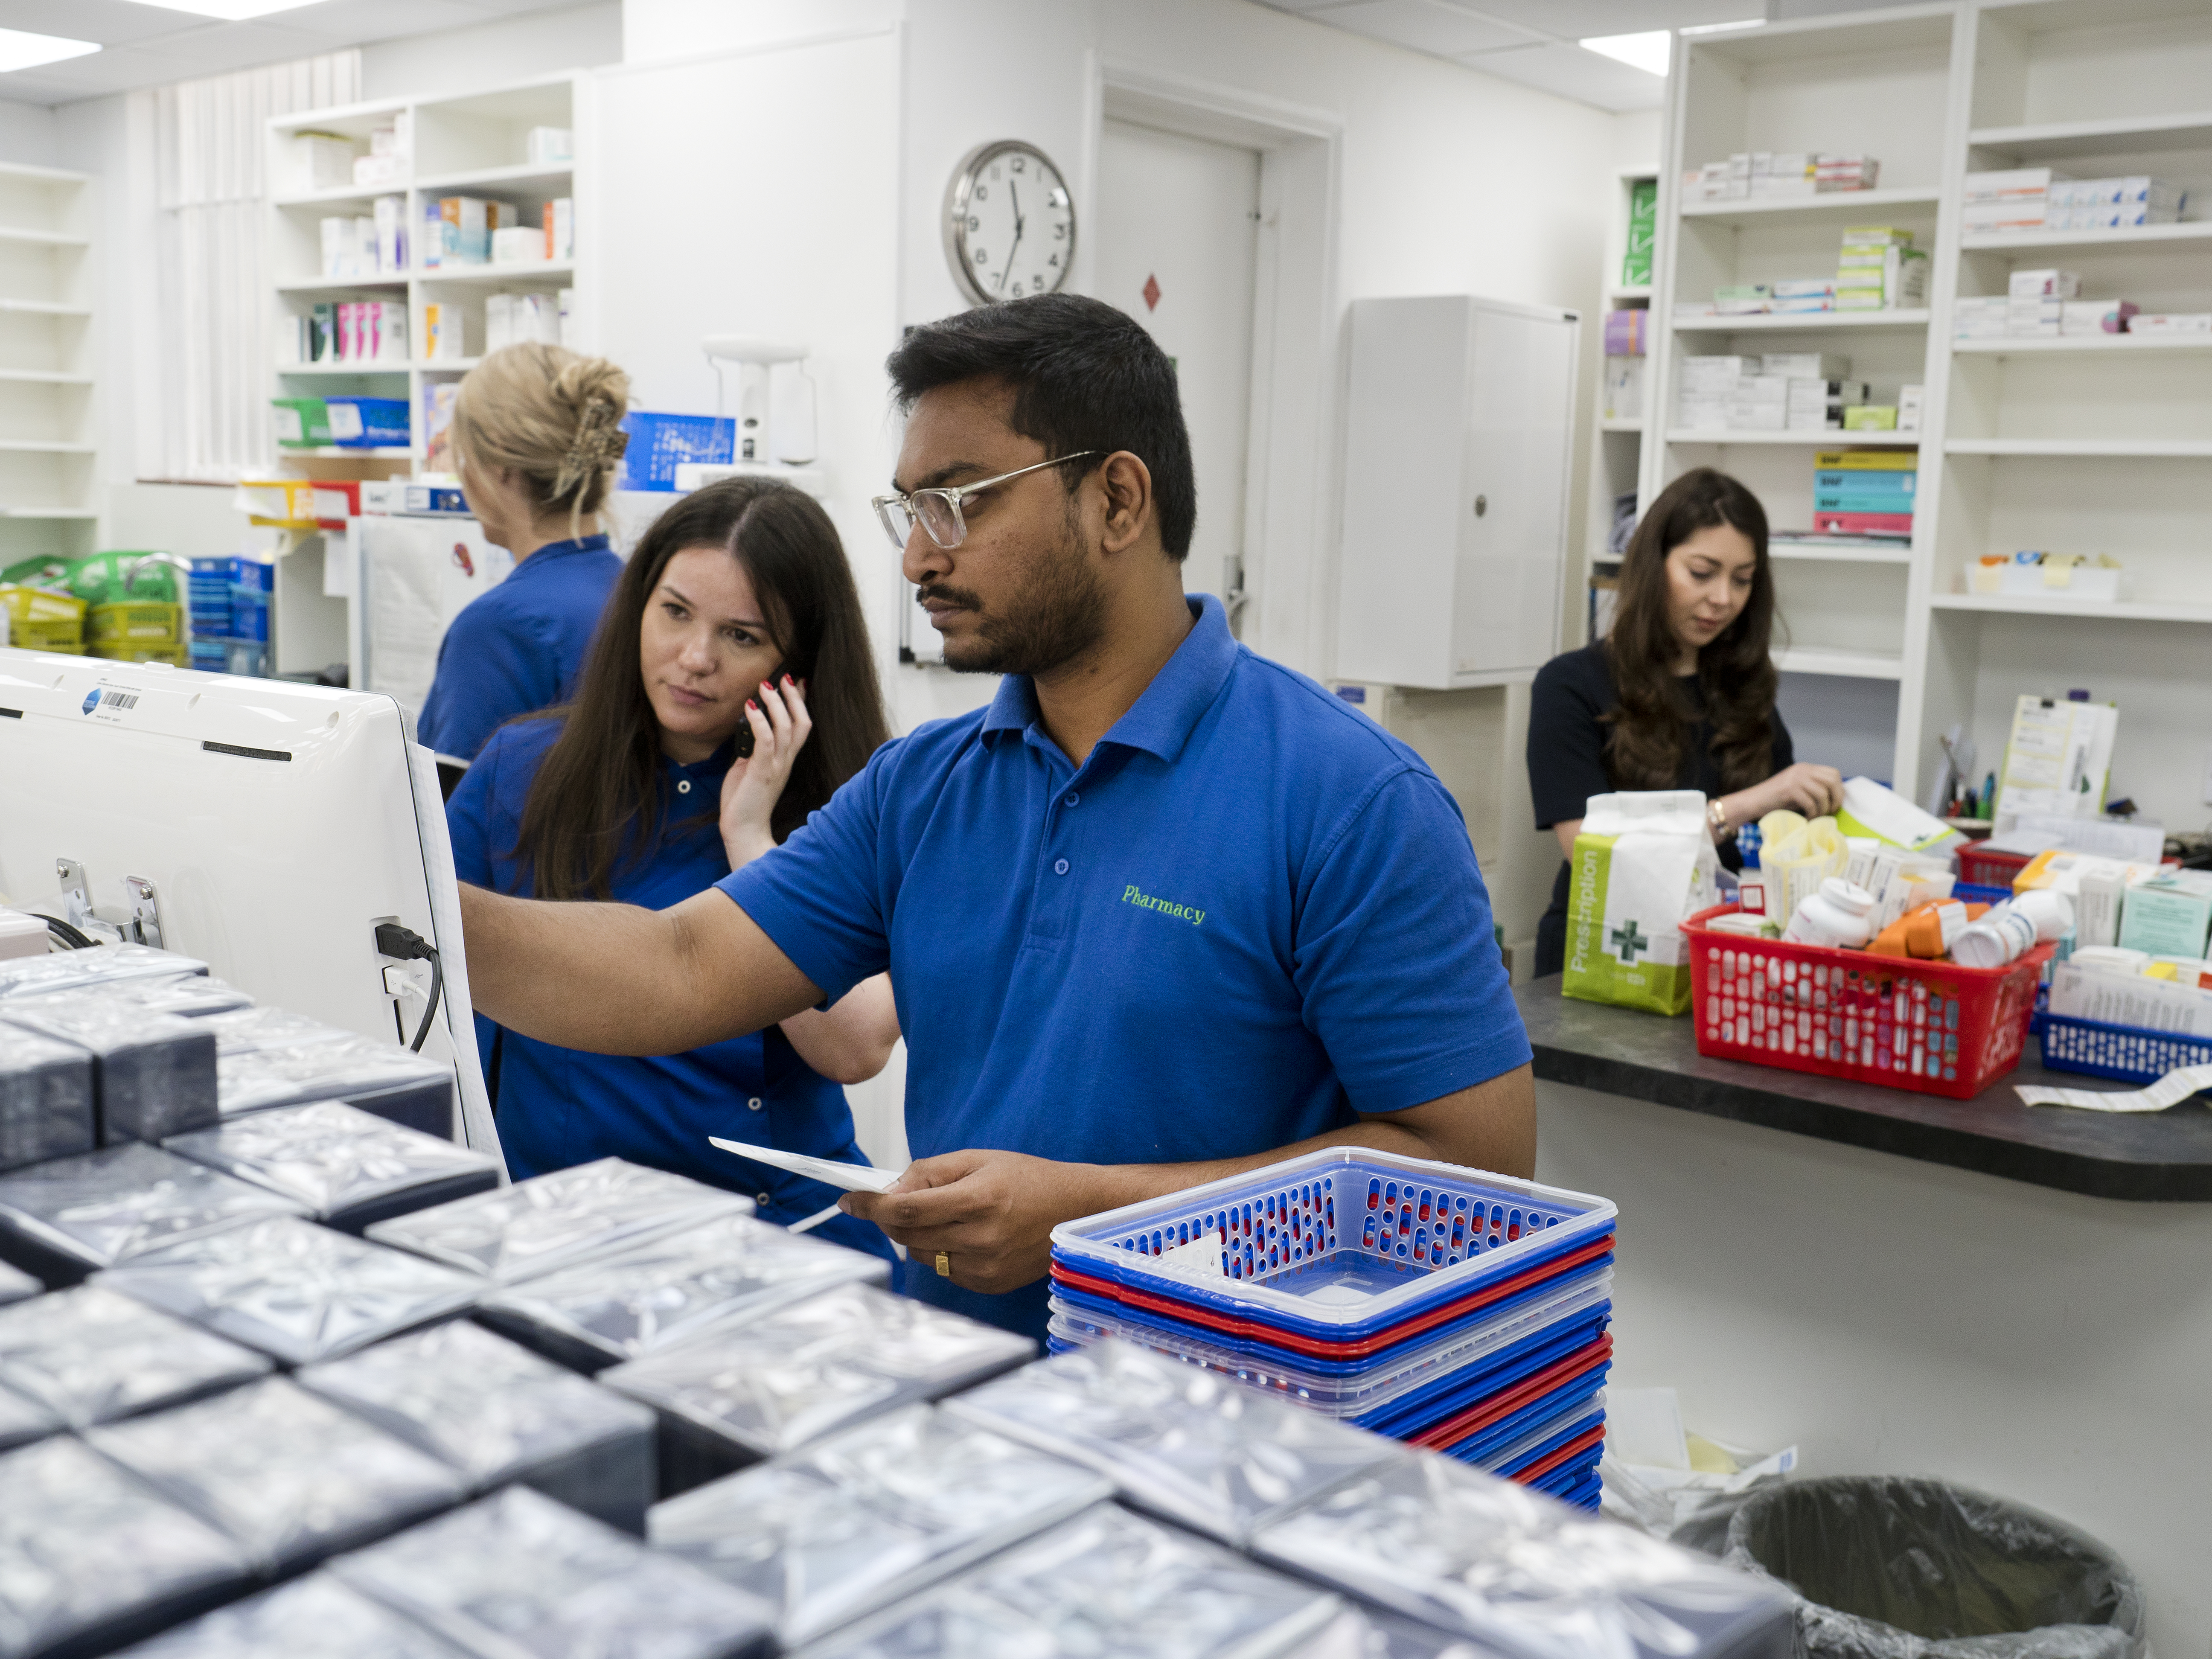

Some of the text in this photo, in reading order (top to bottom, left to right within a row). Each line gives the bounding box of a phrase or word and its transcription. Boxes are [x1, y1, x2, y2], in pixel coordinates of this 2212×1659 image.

[1010, 157, 1025, 174] 12
[1036, 166, 1042, 183] 1
[968, 215, 979, 232] 9
[1054, 223, 1065, 240] 3
[975, 247, 987, 265] 8
[1048, 253, 1059, 267] 4
[991, 272, 1001, 289] 7
[1033, 274, 1044, 291] 5
[1011, 282, 1023, 298] 6
[1121, 885, 1205, 925] Pharmacy
[1570, 850, 1598, 973] Prescription
